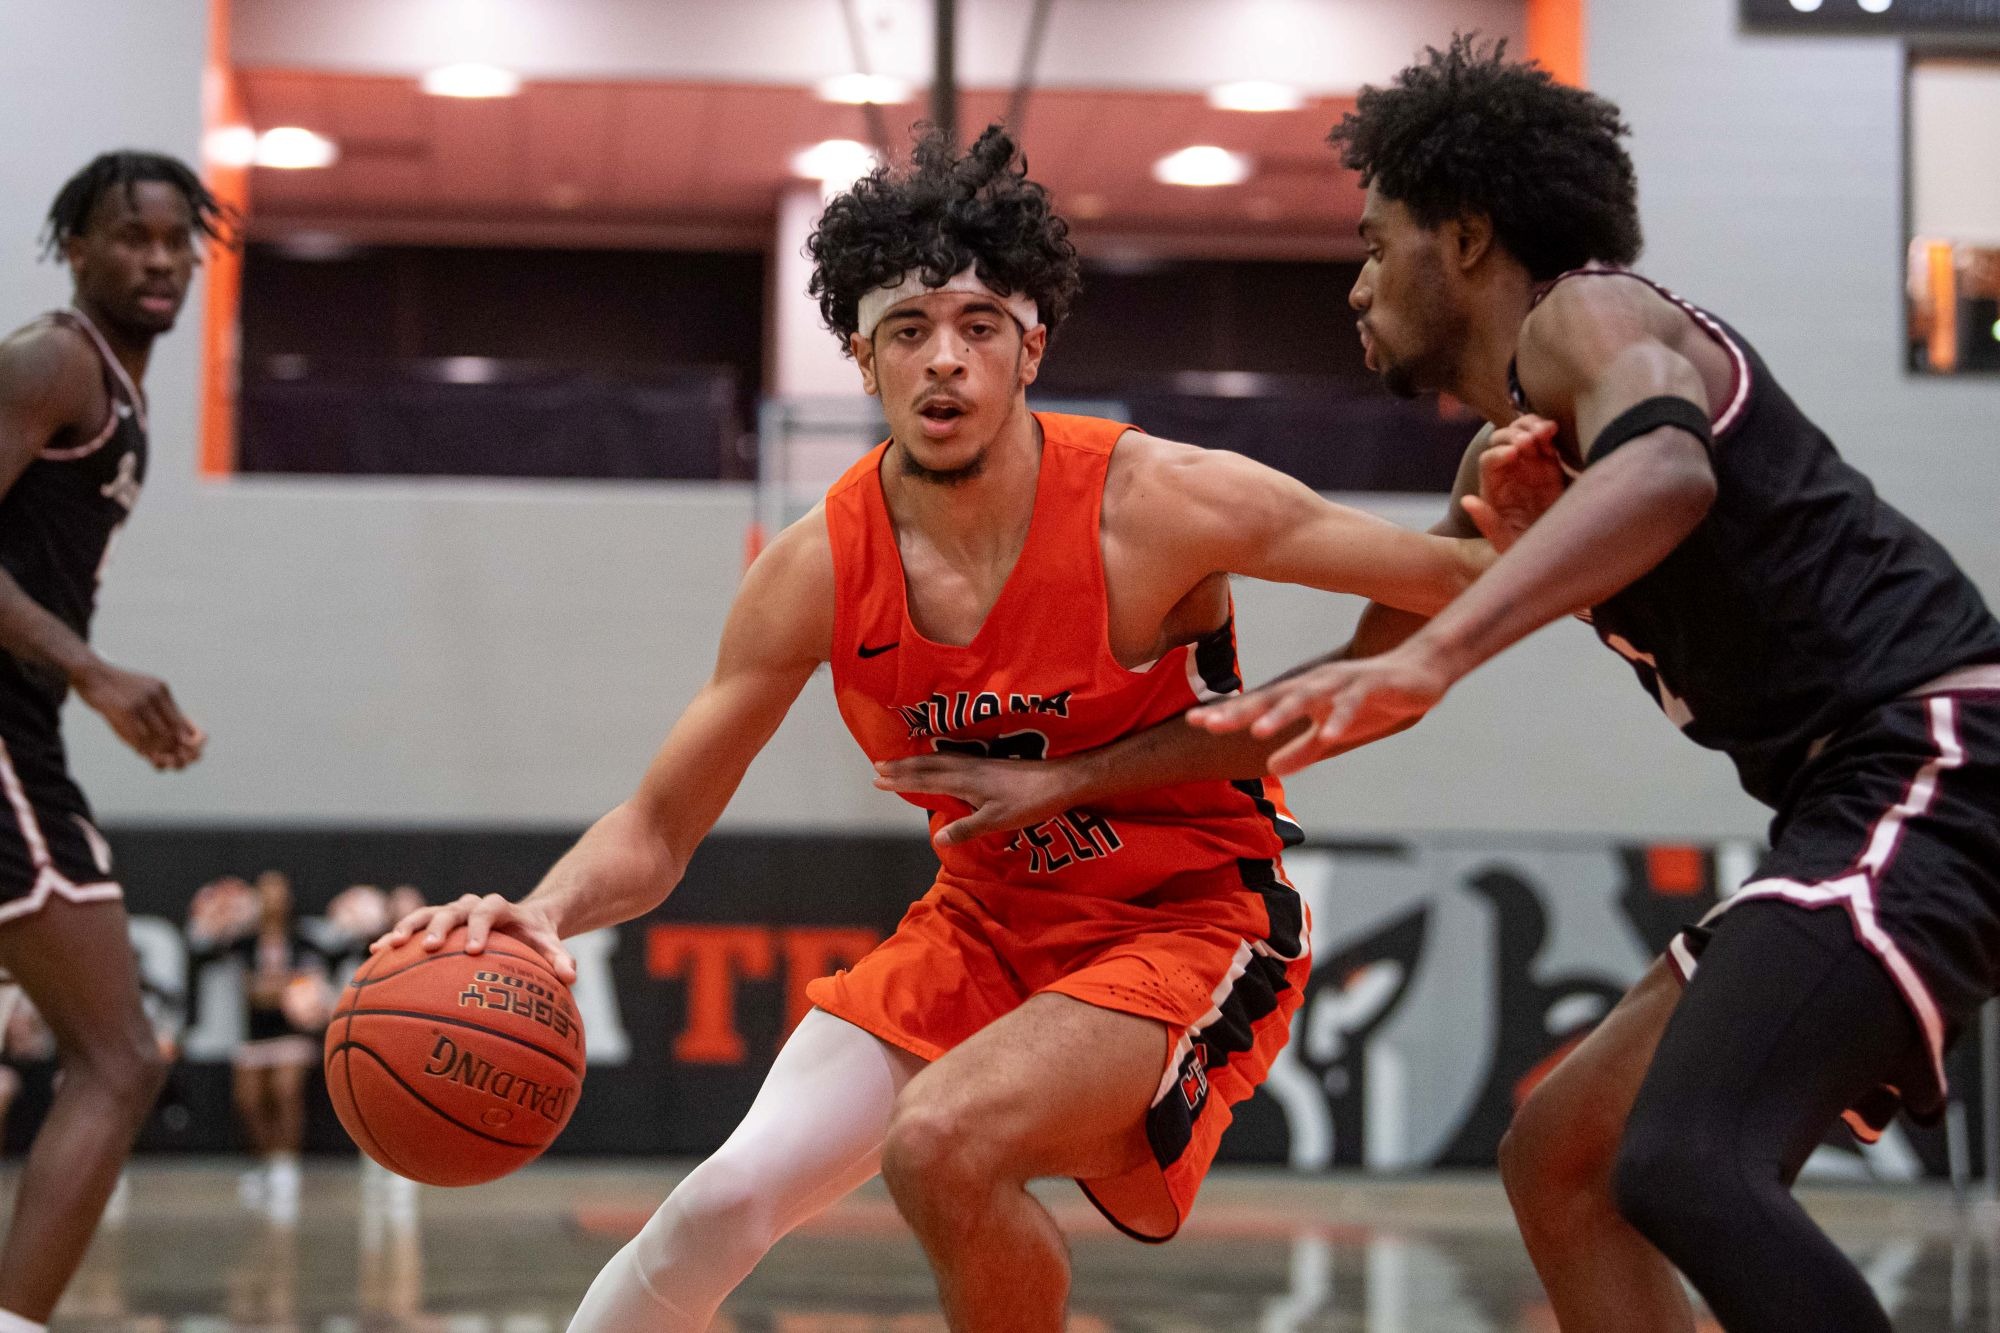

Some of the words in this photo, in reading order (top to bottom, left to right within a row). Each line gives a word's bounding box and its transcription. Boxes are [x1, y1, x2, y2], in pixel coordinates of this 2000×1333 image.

[900, 690, 1072, 740] INDIANA
[475, 970, 555, 1003] 1000
[459, 984, 580, 1051] LEGACY
[424, 1034, 574, 1124] SPALDING
